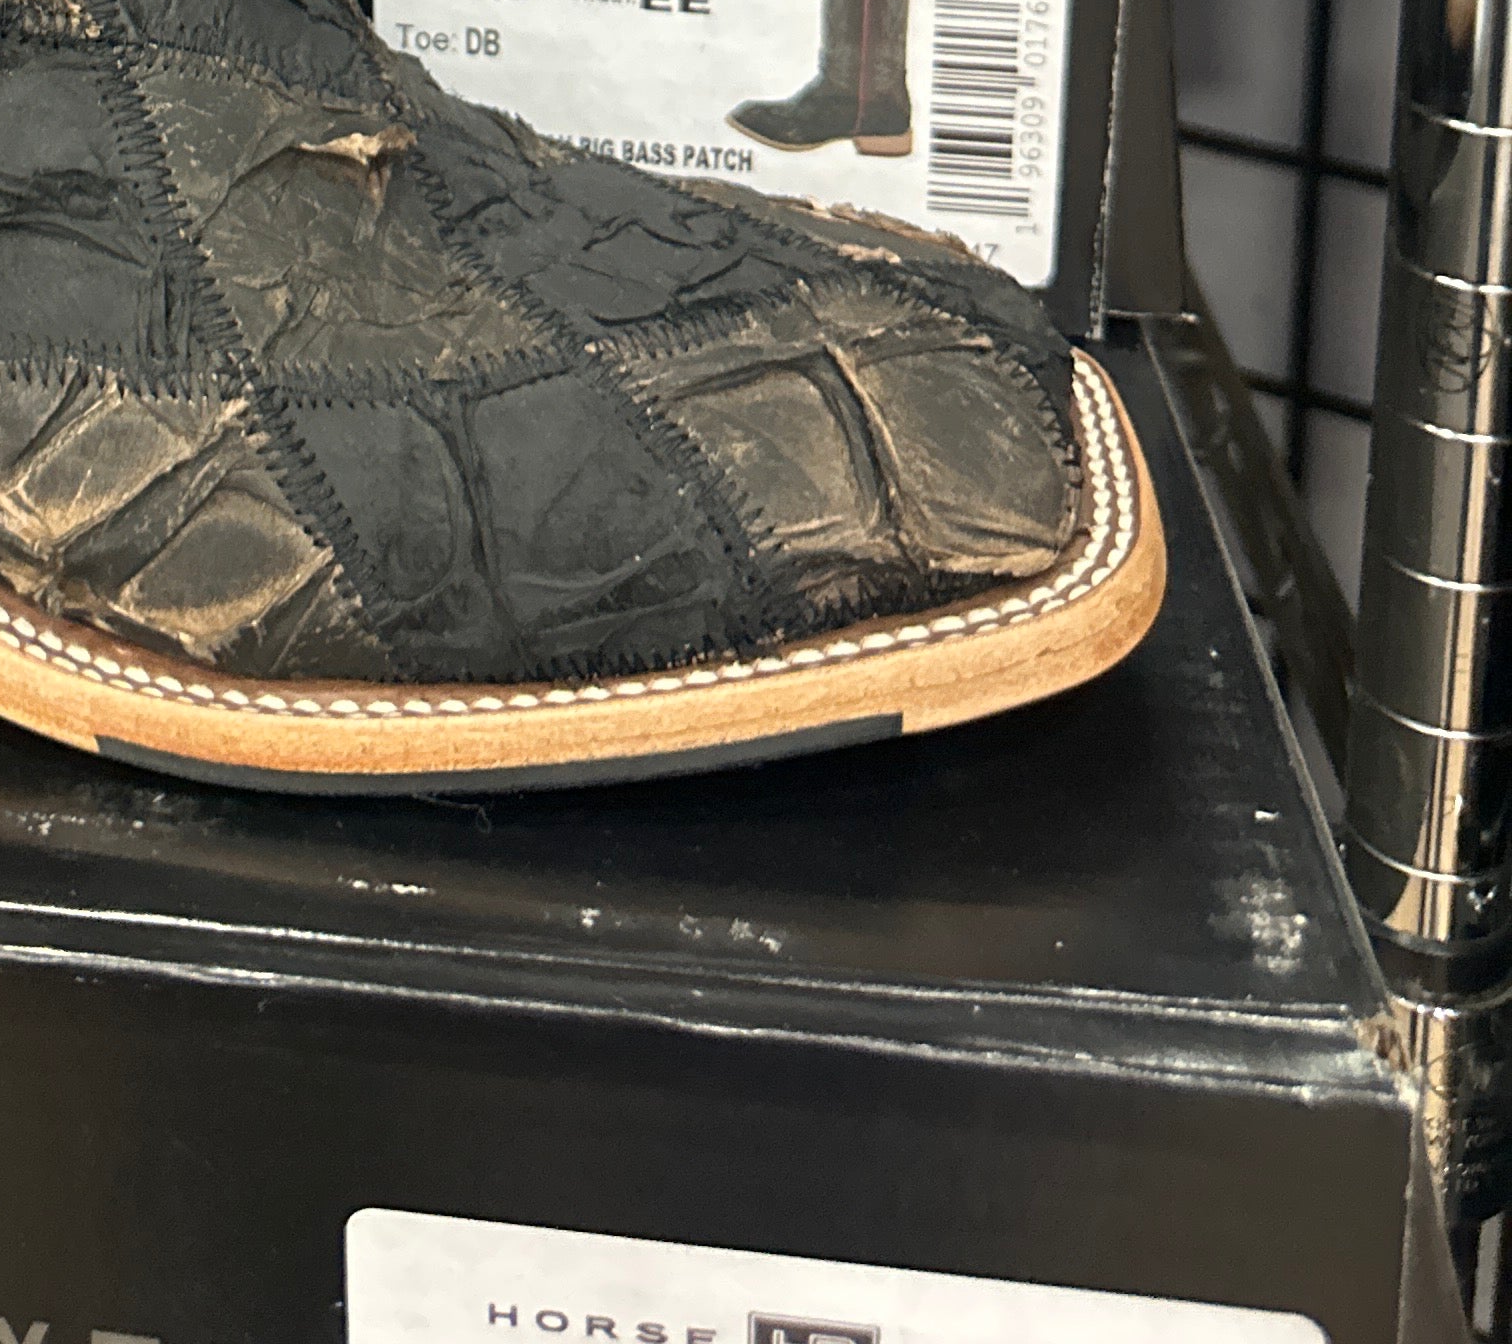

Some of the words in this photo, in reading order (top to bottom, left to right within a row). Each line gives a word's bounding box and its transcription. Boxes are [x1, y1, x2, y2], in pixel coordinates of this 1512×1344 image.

[395, 23, 458, 54] Toe:
[464, 27, 500, 57] DB
[621, 140, 677, 166] BASS
[682, 144, 754, 171] PATCH
[1018, 95, 1046, 179] 96309
[488, 1303, 717, 1344] HORSE
